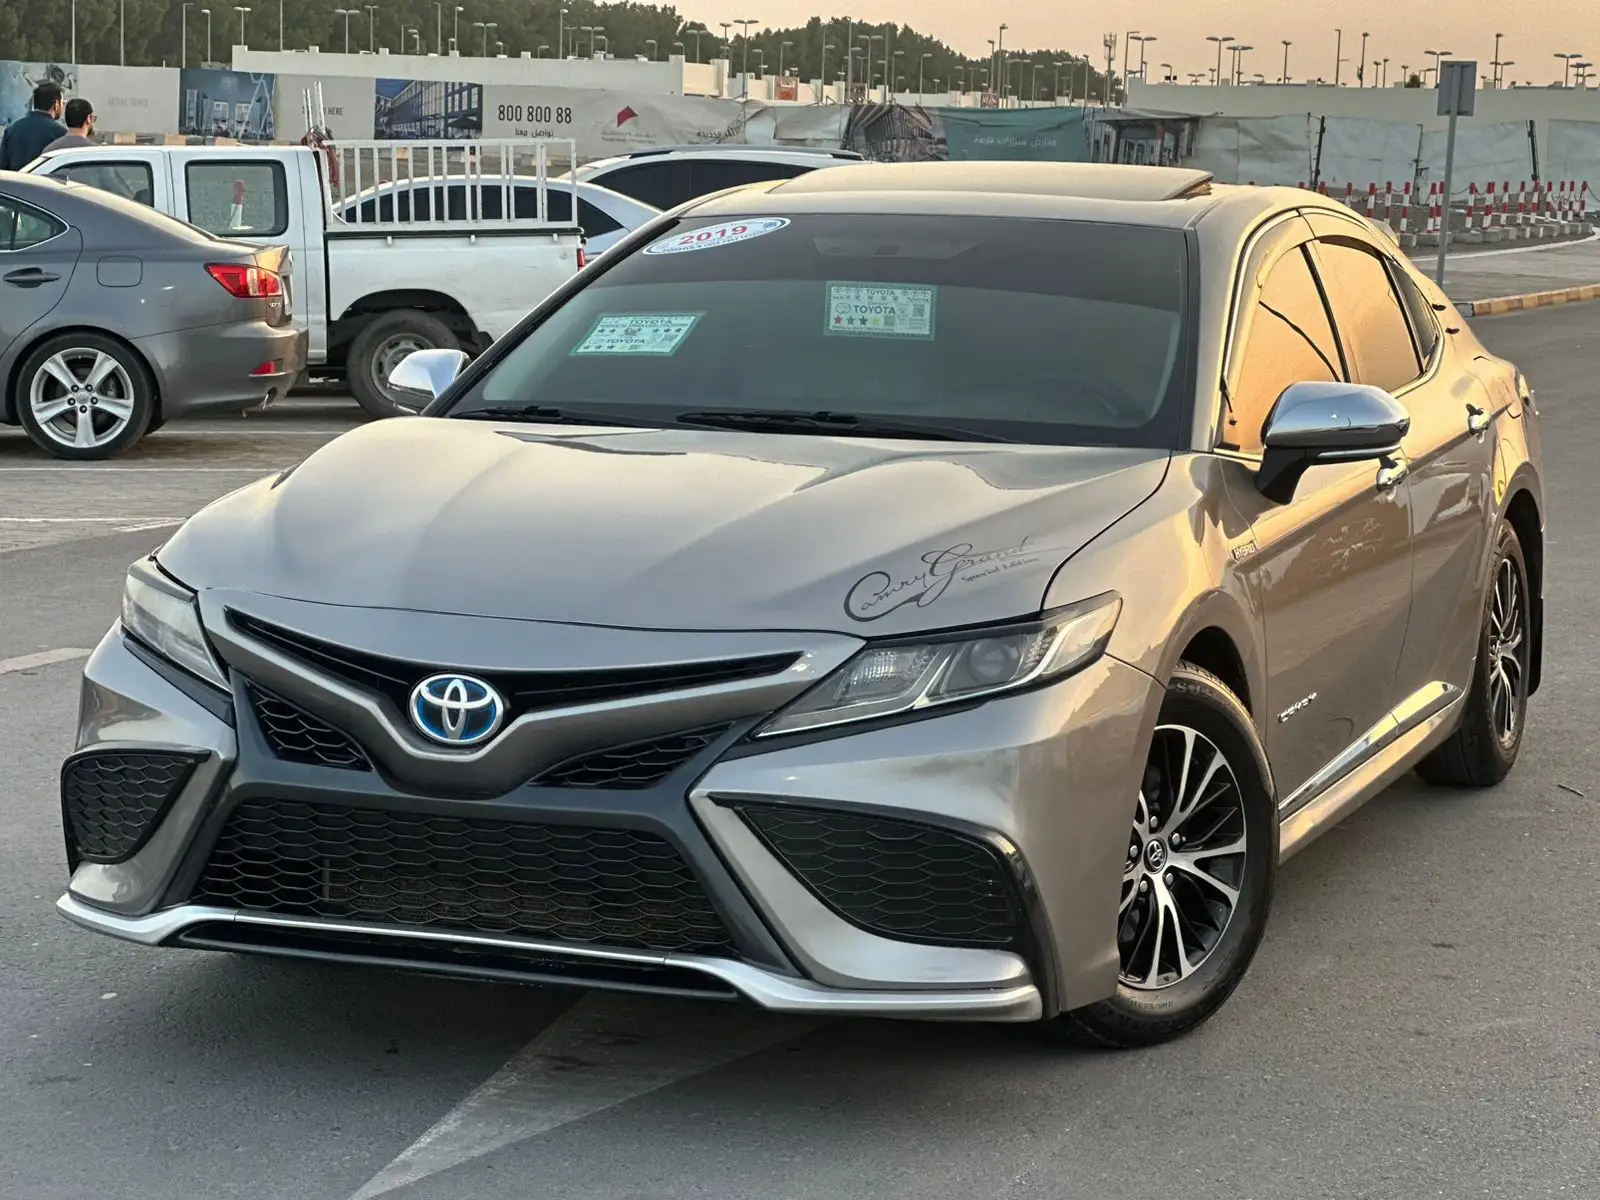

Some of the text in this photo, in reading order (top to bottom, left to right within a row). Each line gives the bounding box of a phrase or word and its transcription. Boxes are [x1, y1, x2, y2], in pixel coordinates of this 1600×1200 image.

[498, 104, 572, 124] 800 800 88
[531, 128, 554, 138] تواصل
[678, 225, 748, 246] 2019
[865, 288, 895, 296] TOYOTA
[853, 304, 896, 315] TOYOTA
[1234, 542, 1255, 559] HYBRID
